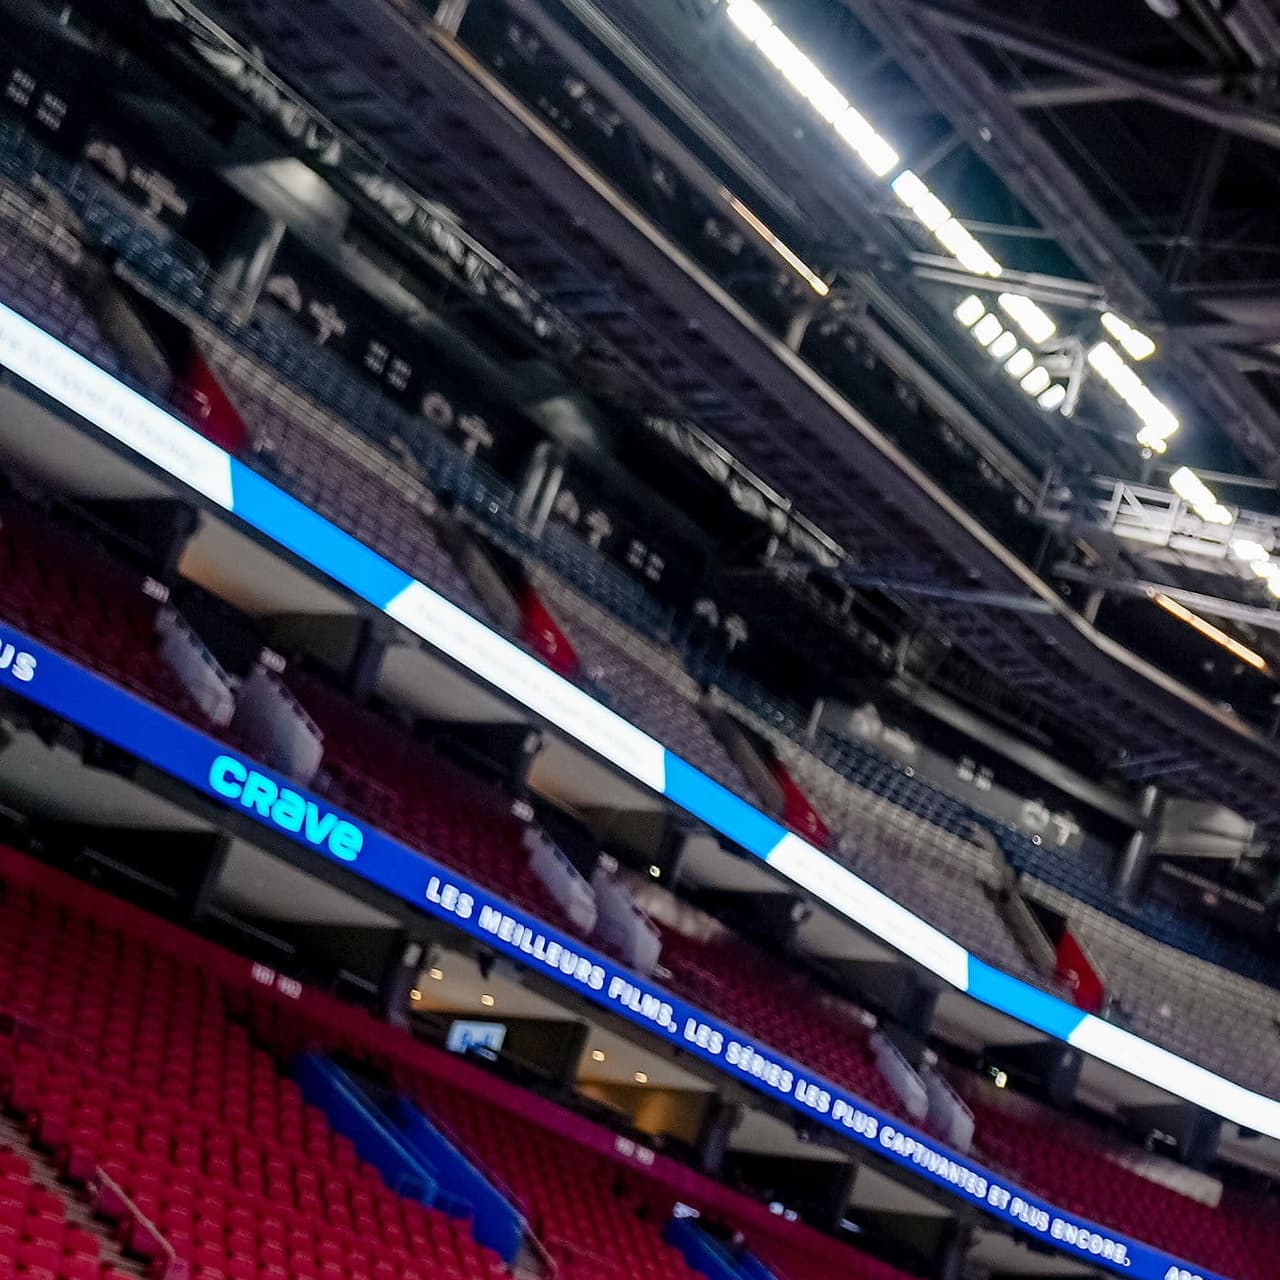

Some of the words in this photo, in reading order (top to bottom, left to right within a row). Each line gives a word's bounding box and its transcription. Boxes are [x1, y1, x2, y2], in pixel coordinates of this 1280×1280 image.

[425, 876, 475, 919] LES
[478, 905, 606, 990] MEILLEURS
[683, 1017, 724, 1055] LES
[794, 1079, 831, 1113] LES
[832, 1099, 879, 1139] PLUS
[879, 1125, 988, 1199] CAPTIVANTES
[987, 1184, 1011, 1210] ET
[1009, 1197, 1049, 1232] PLUS
